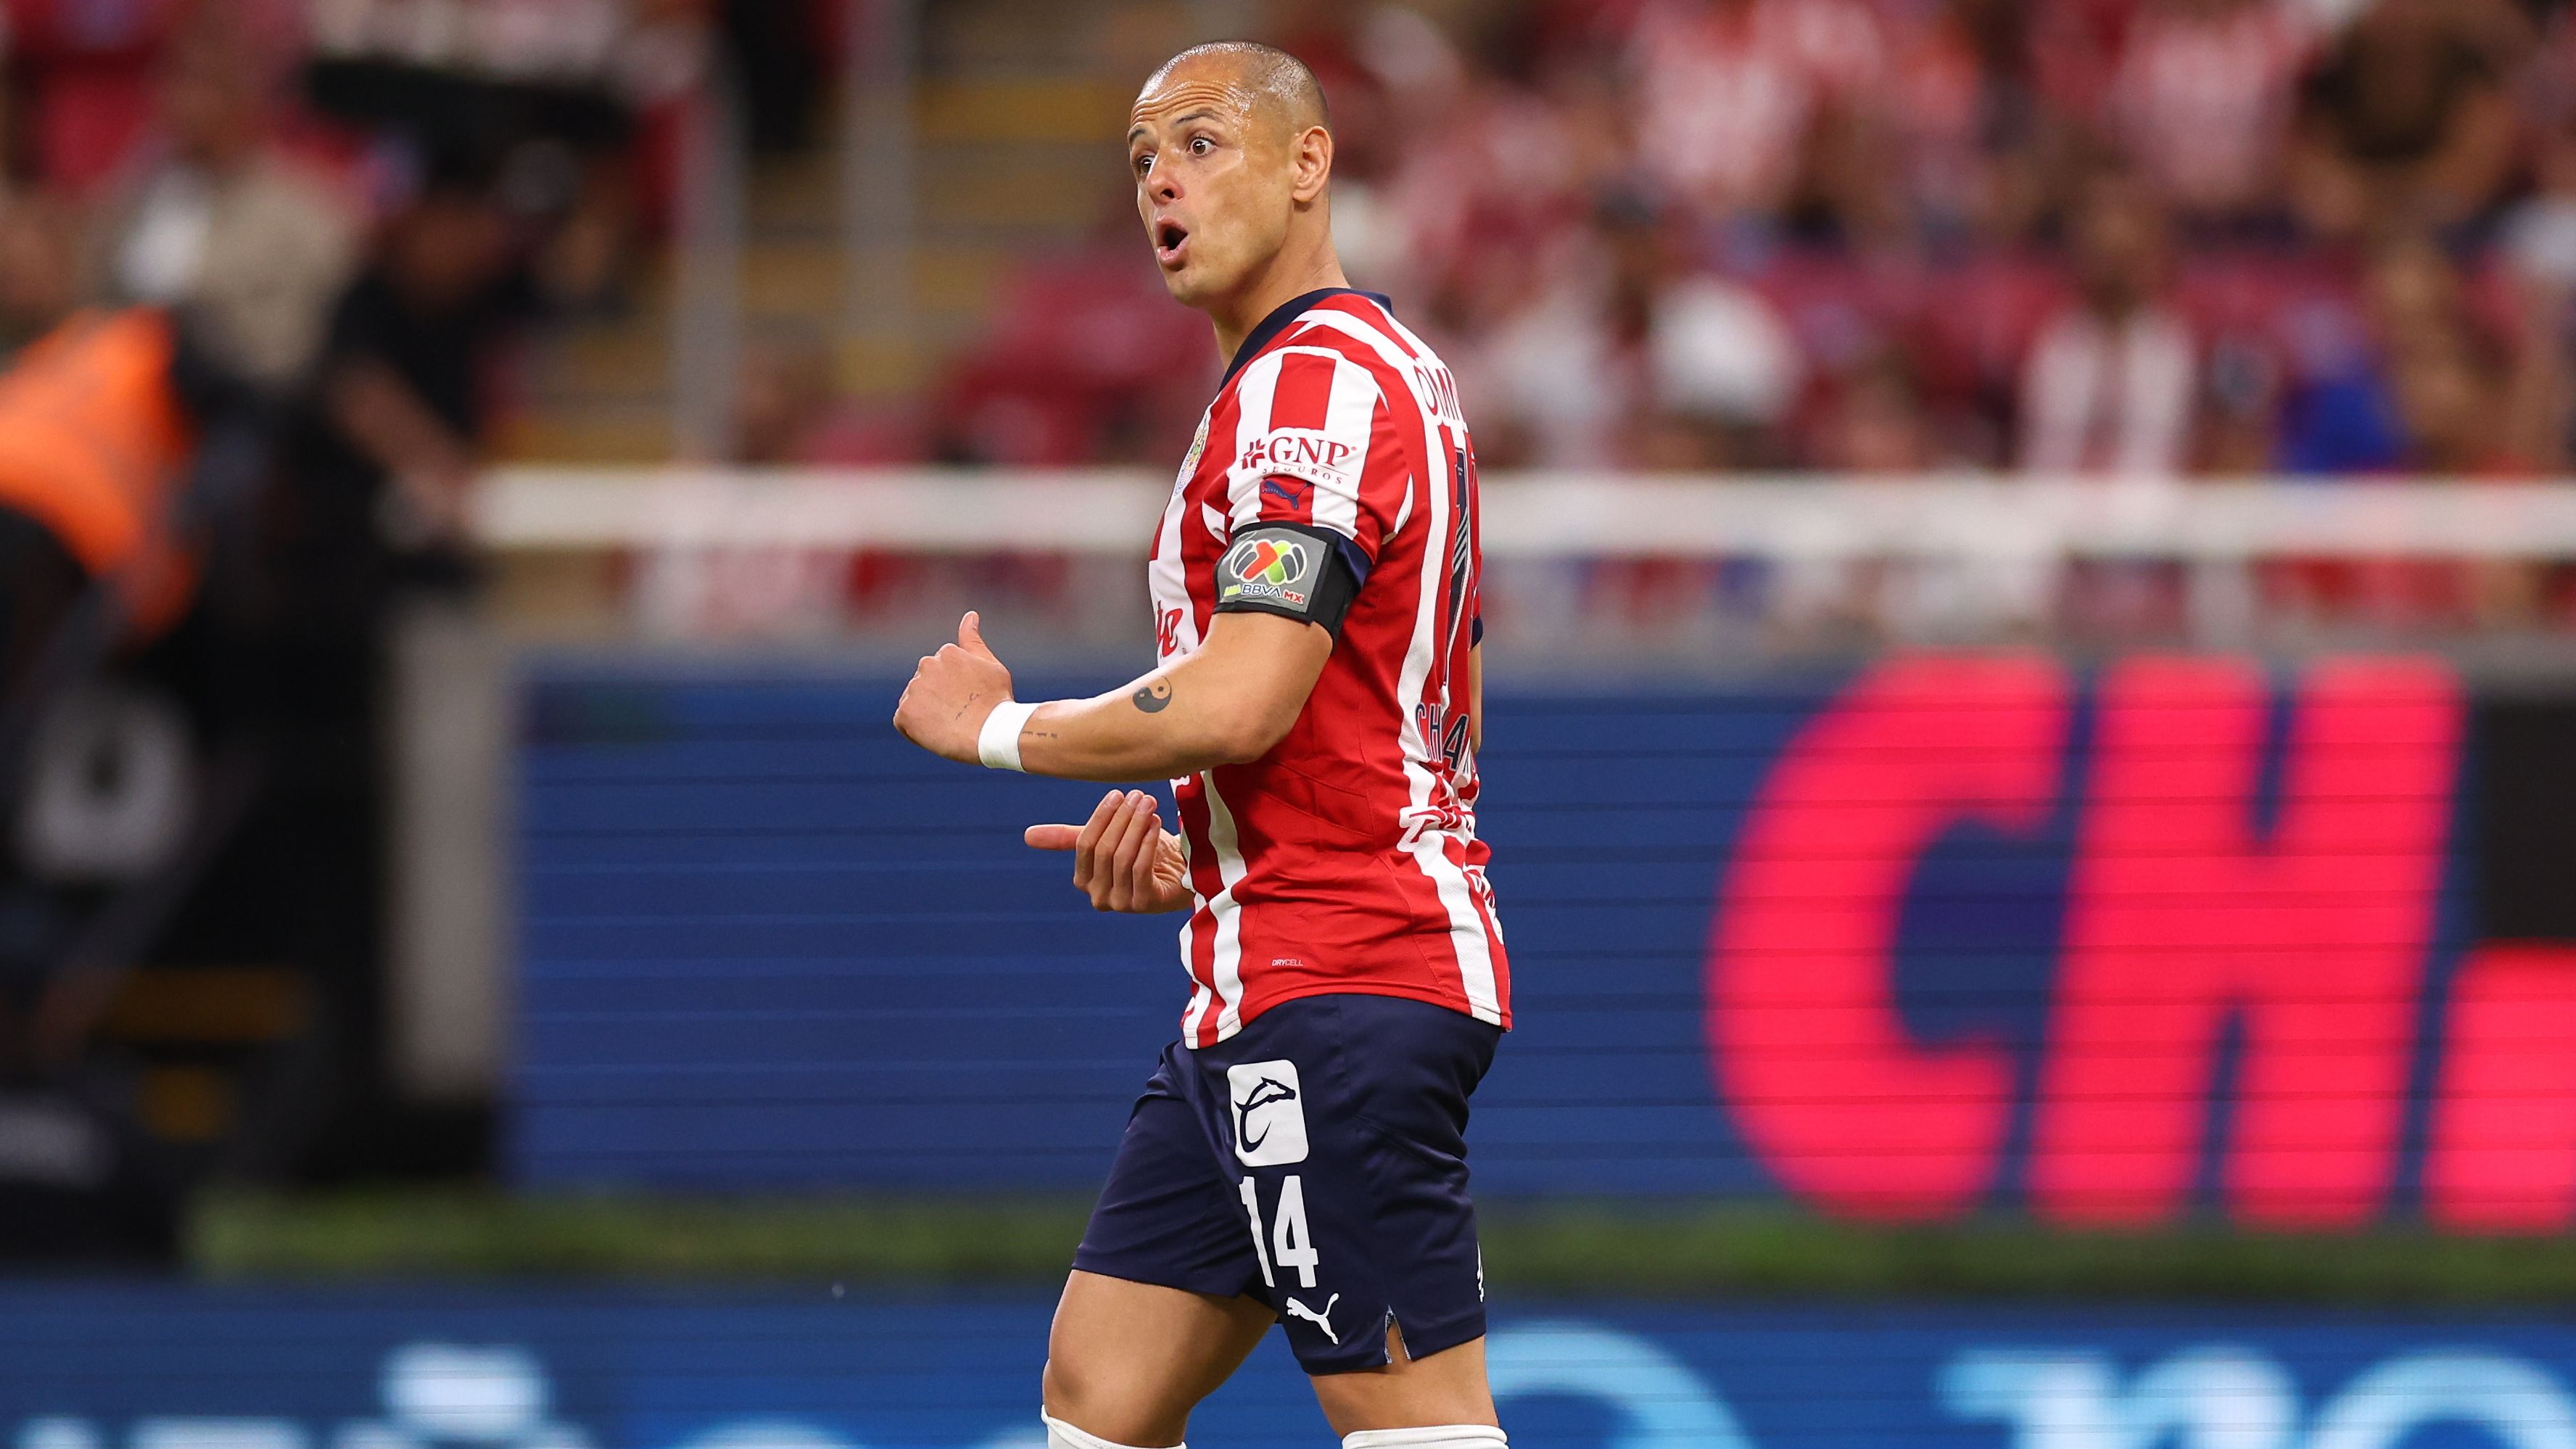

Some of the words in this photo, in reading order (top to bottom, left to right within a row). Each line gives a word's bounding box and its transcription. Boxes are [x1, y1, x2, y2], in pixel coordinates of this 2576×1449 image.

[1269, 437, 1349, 467] GNP
[1241, 584, 1281, 598] BBVA
[1283, 589, 1305, 604] MX
[1239, 1175, 1318, 1288] 14
